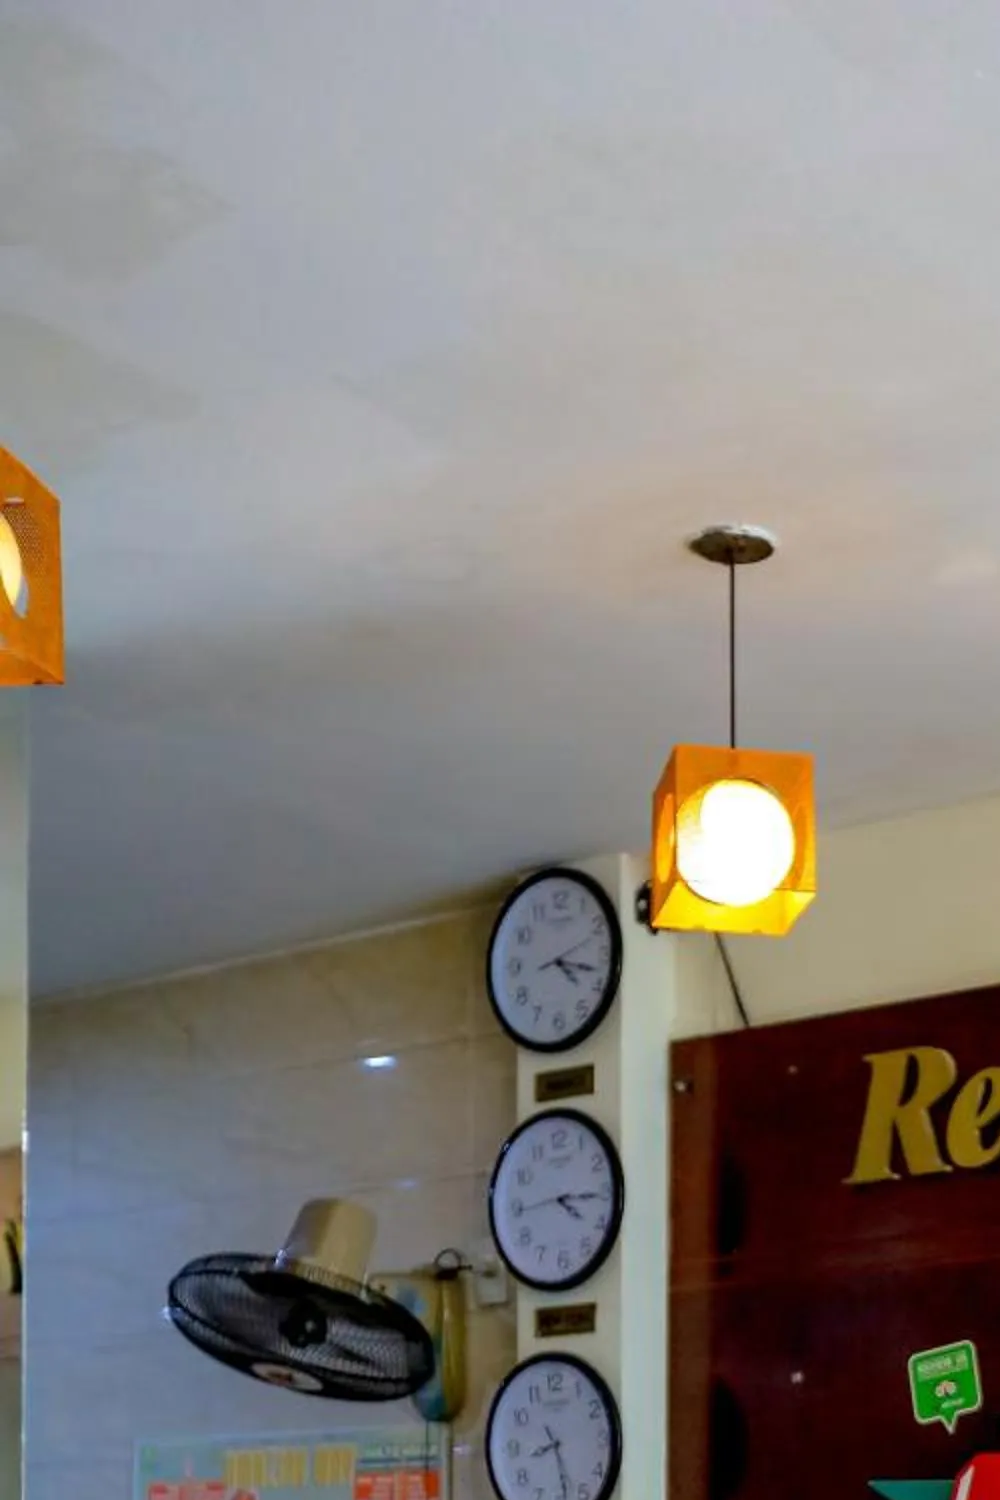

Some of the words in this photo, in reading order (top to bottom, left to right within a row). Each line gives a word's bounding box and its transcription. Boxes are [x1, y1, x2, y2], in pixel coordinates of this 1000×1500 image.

[552, 890, 568, 909] 12
[533, 904, 545, 922] 11
[551, 1129, 567, 1148] 12
[532, 1144, 543, 1161] 11
[591, 1153, 604, 1172] 2
[517, 1166, 532, 1186] 10
[535, 1245, 546, 1264] 7
[546, 1373, 563, 1392] 12
[529, 1385, 539, 1404] 11
[514, 1408, 529, 1426] 10
[589, 1401, 600, 1420] 2
[507, 1438, 520, 1458] 9
[517, 1469, 528, 1486] 8
[592, 1462, 603, 1479] 4
